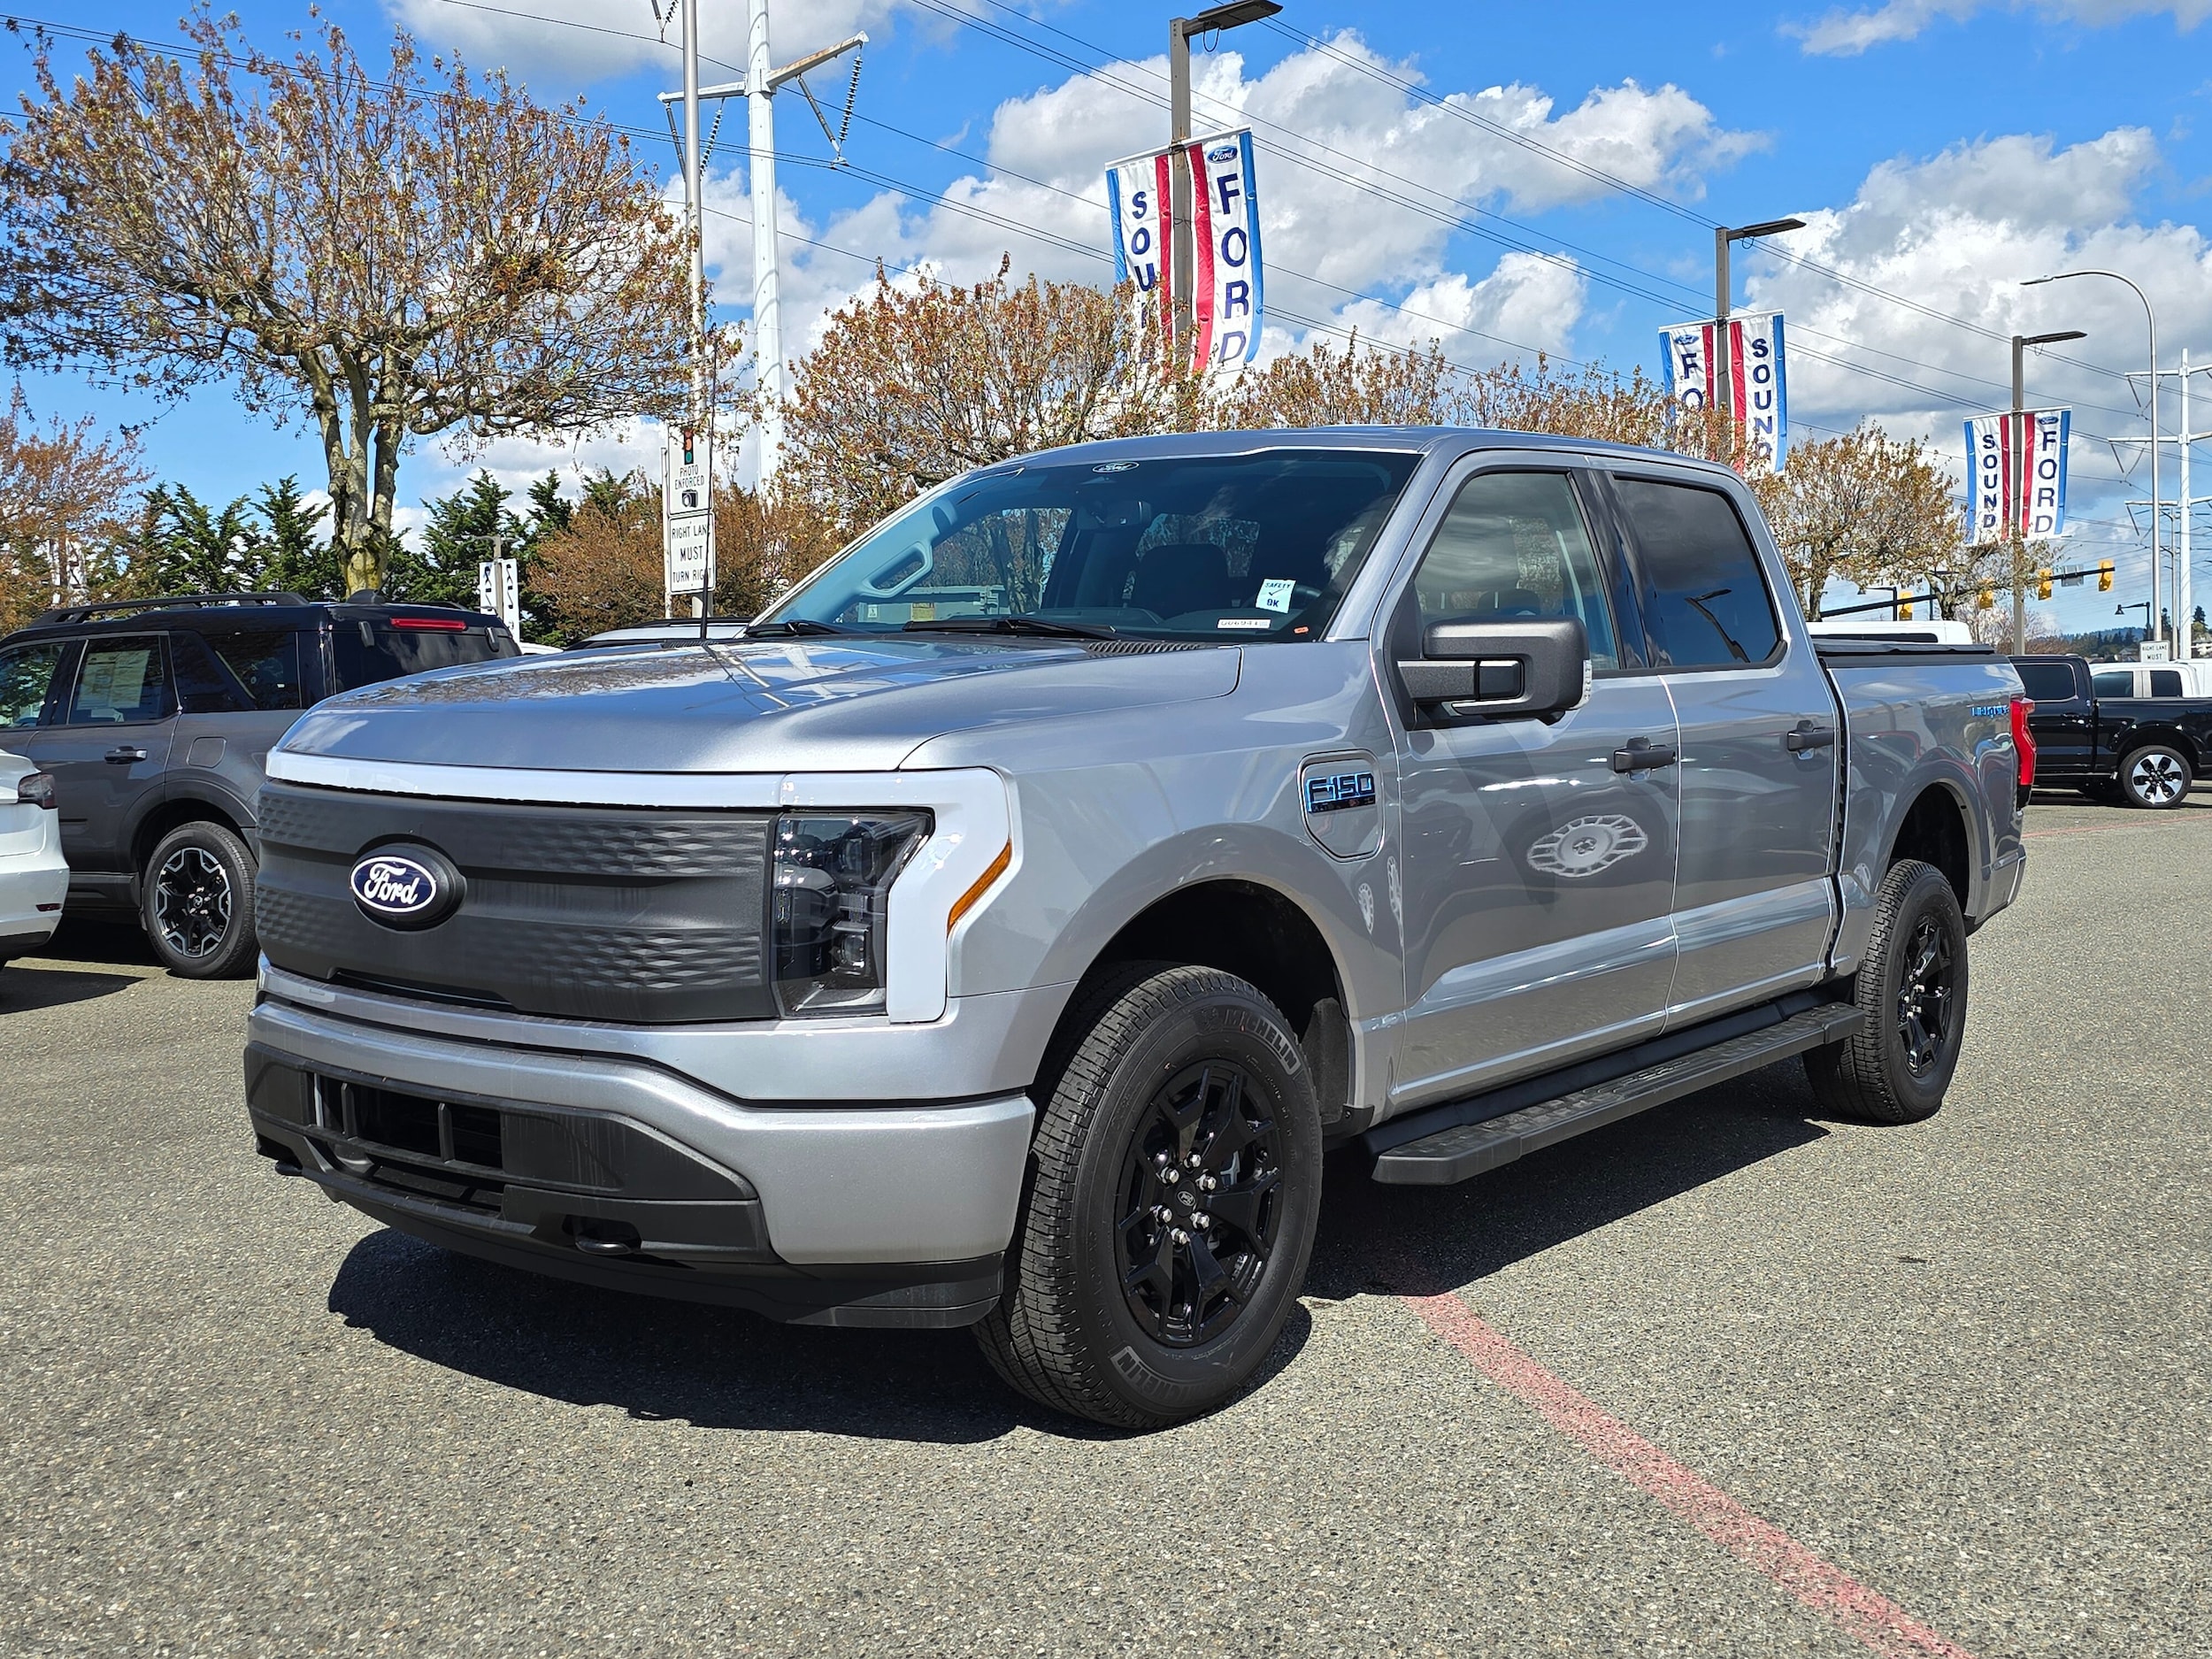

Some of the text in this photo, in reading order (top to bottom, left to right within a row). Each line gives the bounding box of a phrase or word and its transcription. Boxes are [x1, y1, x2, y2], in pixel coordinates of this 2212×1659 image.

[1211, 148, 1234, 162] Ford
[1217, 173, 1249, 364] FORD
[680, 464, 698, 478] PHOTO
[675, 474, 704, 489] ENFORCED
[1982, 434, 1998, 528] SOUND
[2035, 431, 2057, 533] FORD
[672, 523, 710, 539] RIGHT LAN
[680, 545, 703, 562] MUST
[672, 567, 711, 583] TURN RIGT
[1266, 598, 1279, 607] OK
[364, 863, 420, 904] Ford
[1224, 1008, 1298, 1070] MICHELIN
